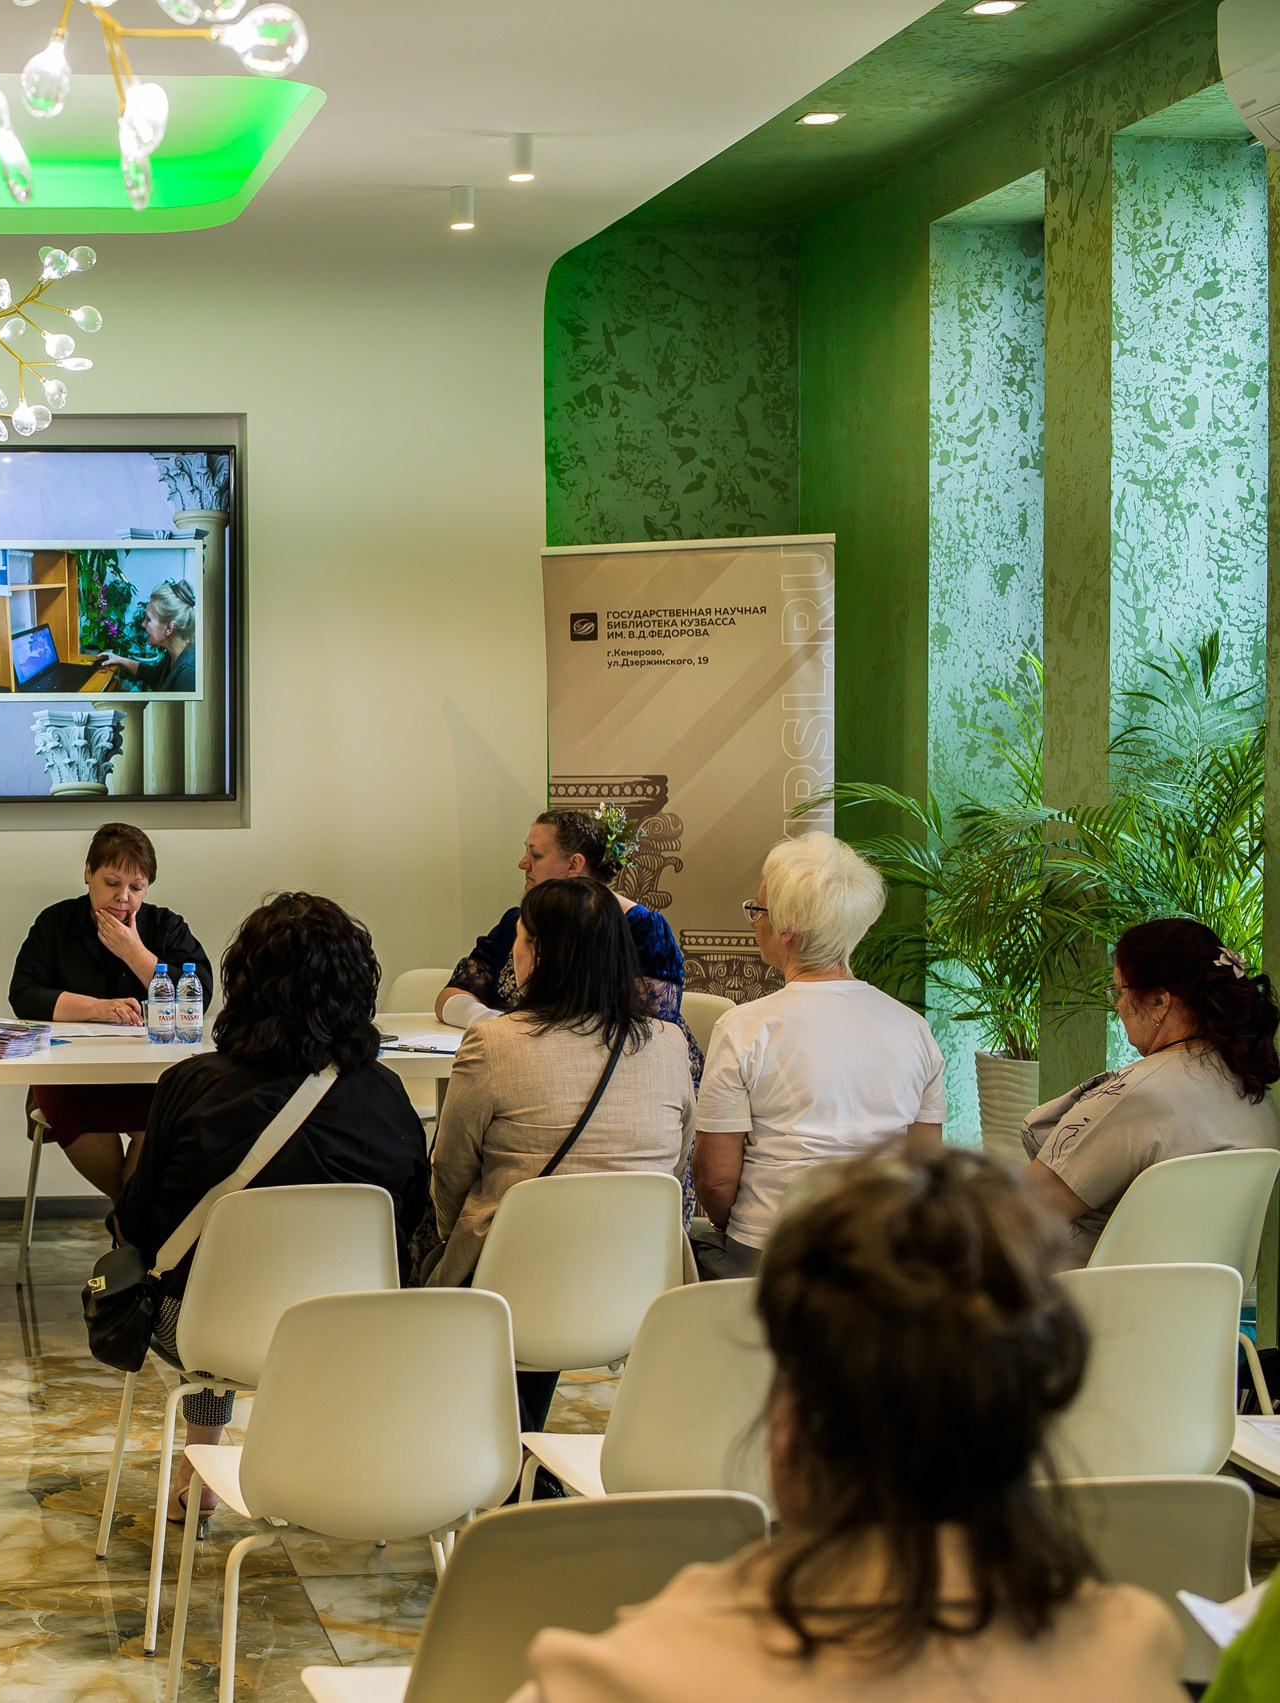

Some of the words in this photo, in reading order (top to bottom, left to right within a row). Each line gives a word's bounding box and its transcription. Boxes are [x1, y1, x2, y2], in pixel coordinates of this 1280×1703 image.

[606, 608, 712, 620] ГОСУДАРСТВЕННАЯ
[714, 606, 767, 616] НАУЧНАЯ
[607, 619, 678, 630] БИБЛИОТЕКА
[680, 617, 736, 627] КУЗБАССА
[607, 631, 626, 639] ИМ.
[628, 628, 709, 640] В.Д.ФЕДОРОВА
[607, 649, 665, 658] г.Кемерово,
[607, 657, 696, 669] ул.Дзержинского,
[697, 656, 709, 665] 19
[781, 544, 835, 842] RSL.RU
